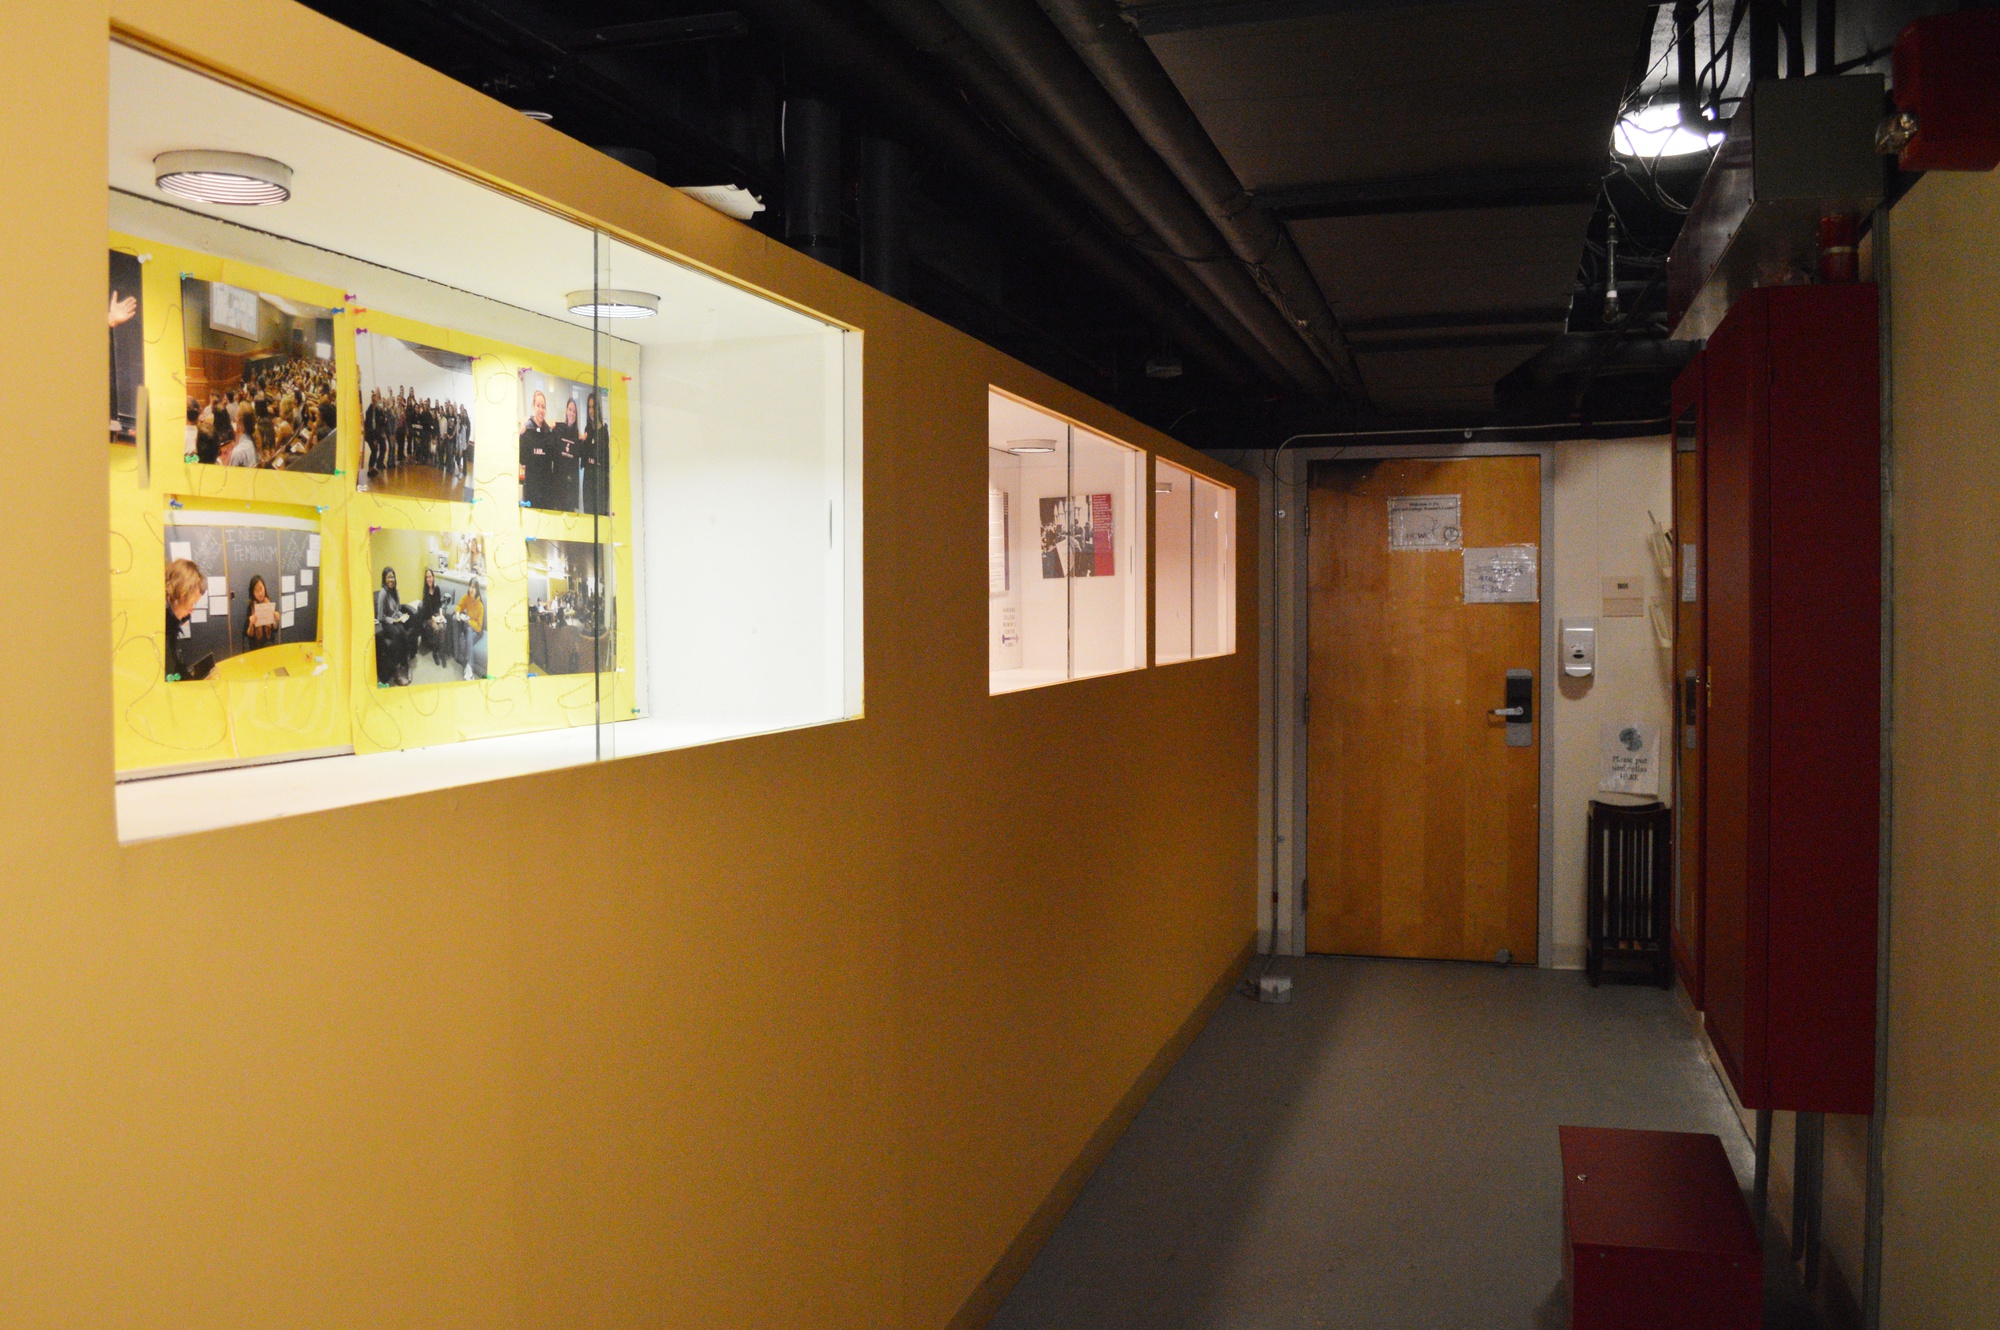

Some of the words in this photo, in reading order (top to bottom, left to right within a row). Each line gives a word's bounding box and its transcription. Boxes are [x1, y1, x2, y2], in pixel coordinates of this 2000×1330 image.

[225, 529, 236, 543] I
[238, 530, 264, 542] NEED
[234, 544, 278, 562] FEMINISM
